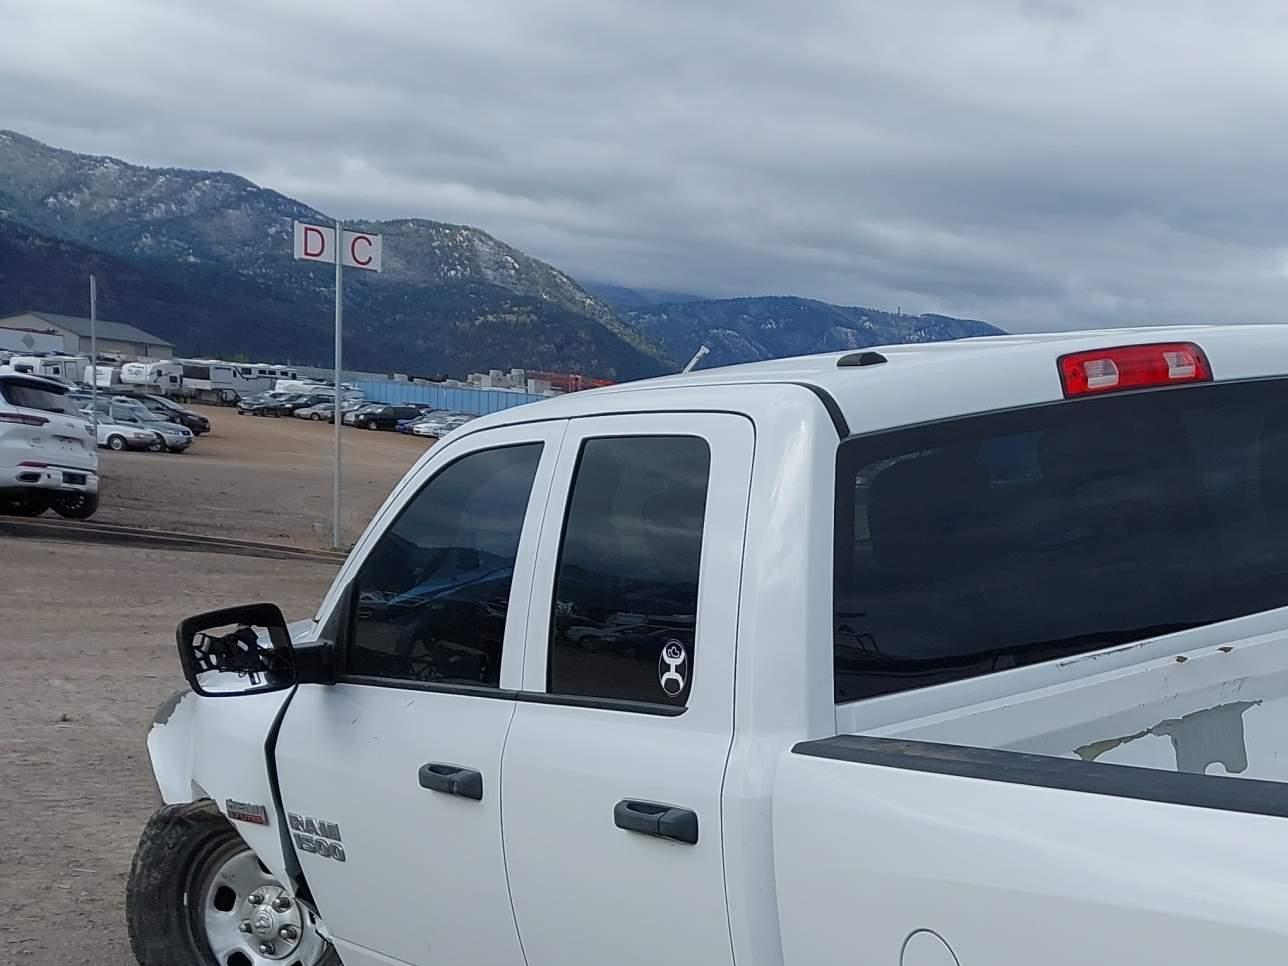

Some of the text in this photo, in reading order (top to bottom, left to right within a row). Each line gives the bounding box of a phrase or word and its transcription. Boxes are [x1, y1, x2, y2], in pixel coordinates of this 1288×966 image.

[303, 226, 325, 257] D
[351, 235, 373, 266] C
[287, 812, 342, 842] RAM
[292, 831, 346, 863] 1500
